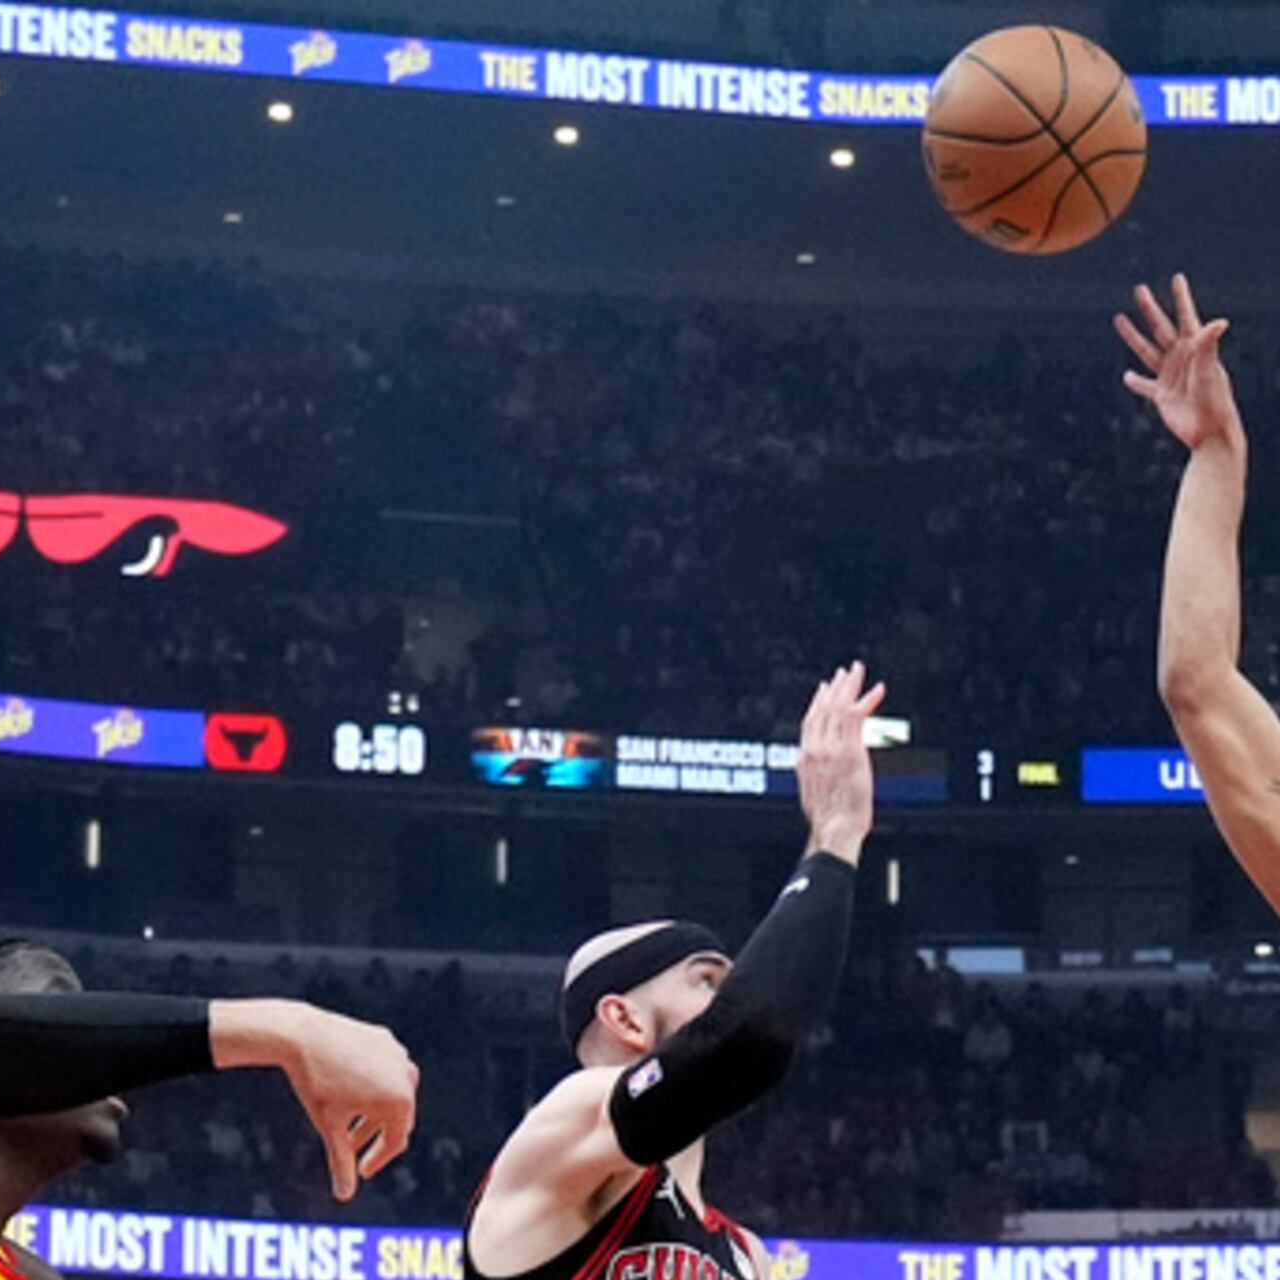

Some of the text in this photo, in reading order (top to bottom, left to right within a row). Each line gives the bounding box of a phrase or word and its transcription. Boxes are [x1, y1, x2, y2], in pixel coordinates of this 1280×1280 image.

[126, 20, 243, 65] SNACKS
[480, 52, 927, 118] THE MOST INTENSE SNACKS
[1161, 84, 1217, 118] THE
[333, 722, 425, 775] 8:50
[51, 1209, 172, 1272] MOST
[376, 1236, 464, 1280] SNAC
